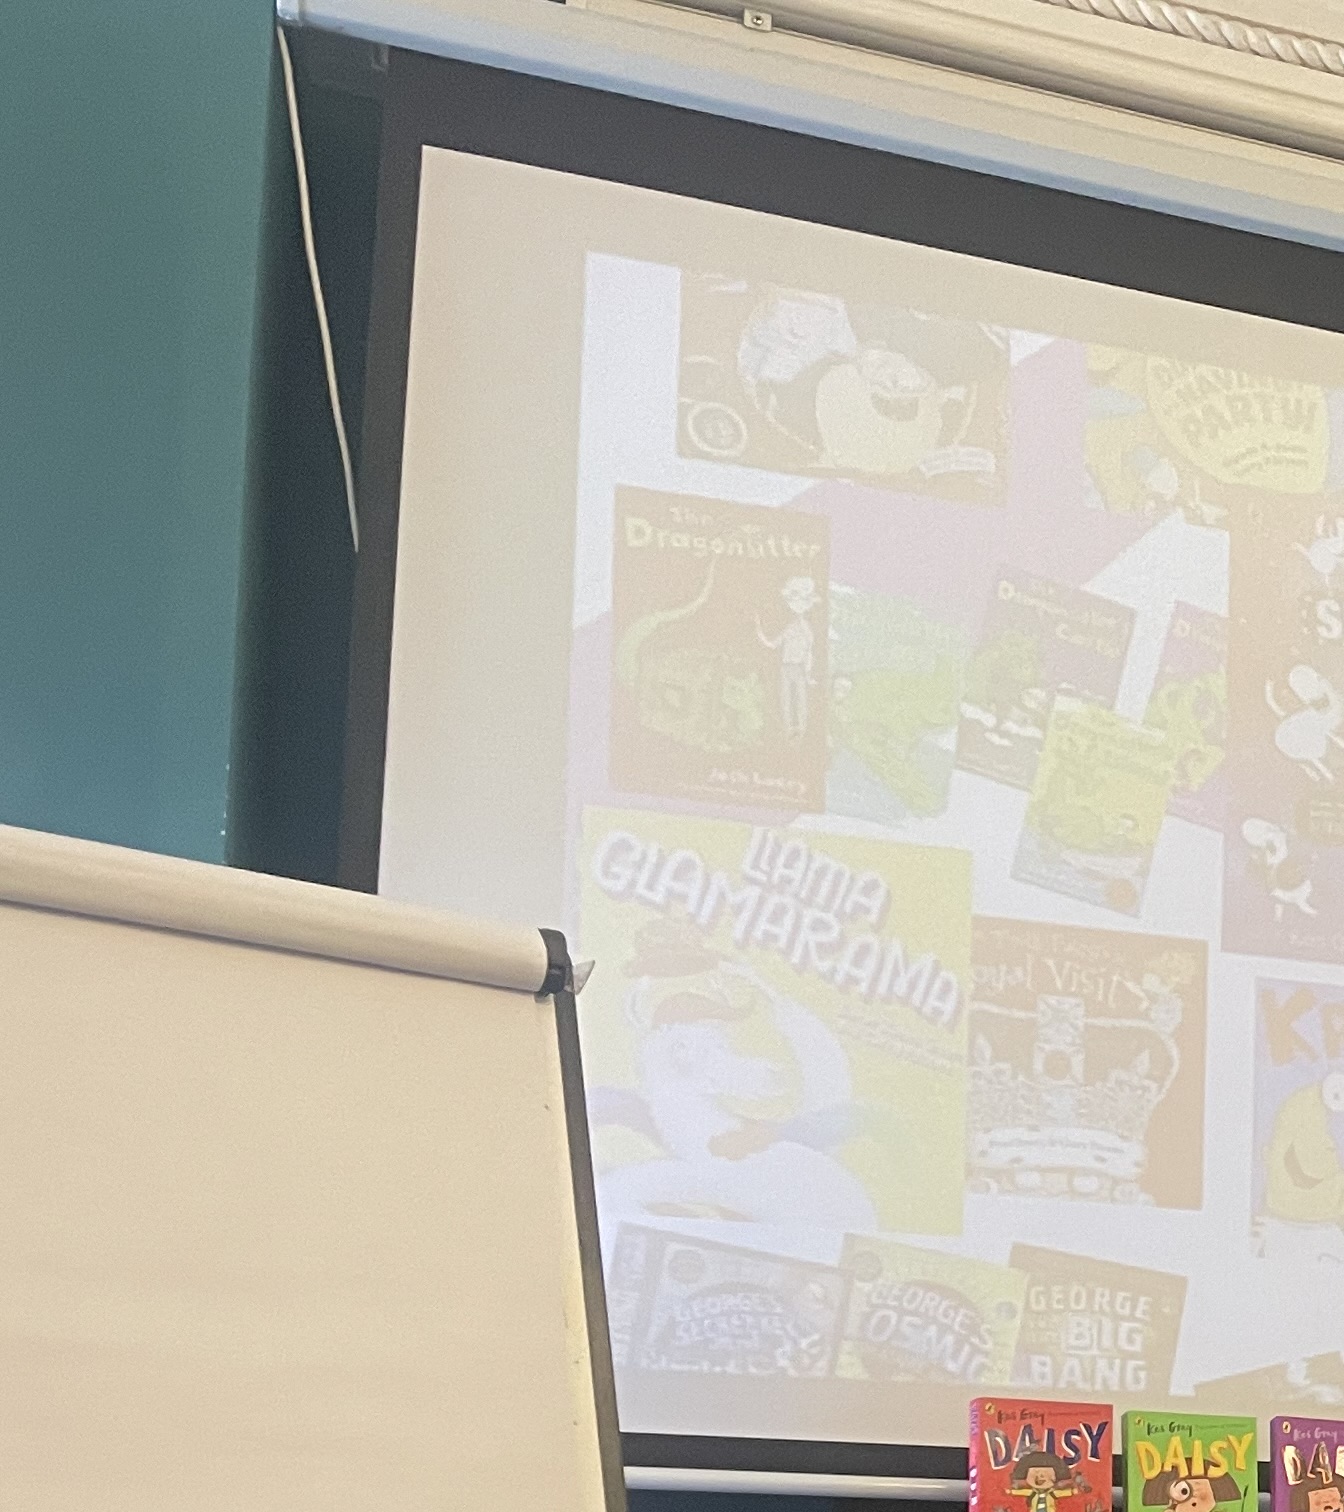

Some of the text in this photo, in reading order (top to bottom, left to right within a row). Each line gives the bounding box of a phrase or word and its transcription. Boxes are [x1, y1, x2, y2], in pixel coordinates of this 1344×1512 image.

[743, 822, 891, 927] LLAMA
[593, 829, 964, 1027] GLAMARAMA
[1029, 1284, 1152, 1320] GEORGE
[865, 1307, 998, 1383] OSMIC
[1066, 1315, 1145, 1354] BIG
[1029, 1354, 1148, 1392] BANG
[984, 1421, 1109, 1470] DAISY
[1147, 1421, 1193, 1437] Kes Gray
[1314, 1426, 1338, 1442] Gray
[1135, 1432, 1254, 1480] DAISY
